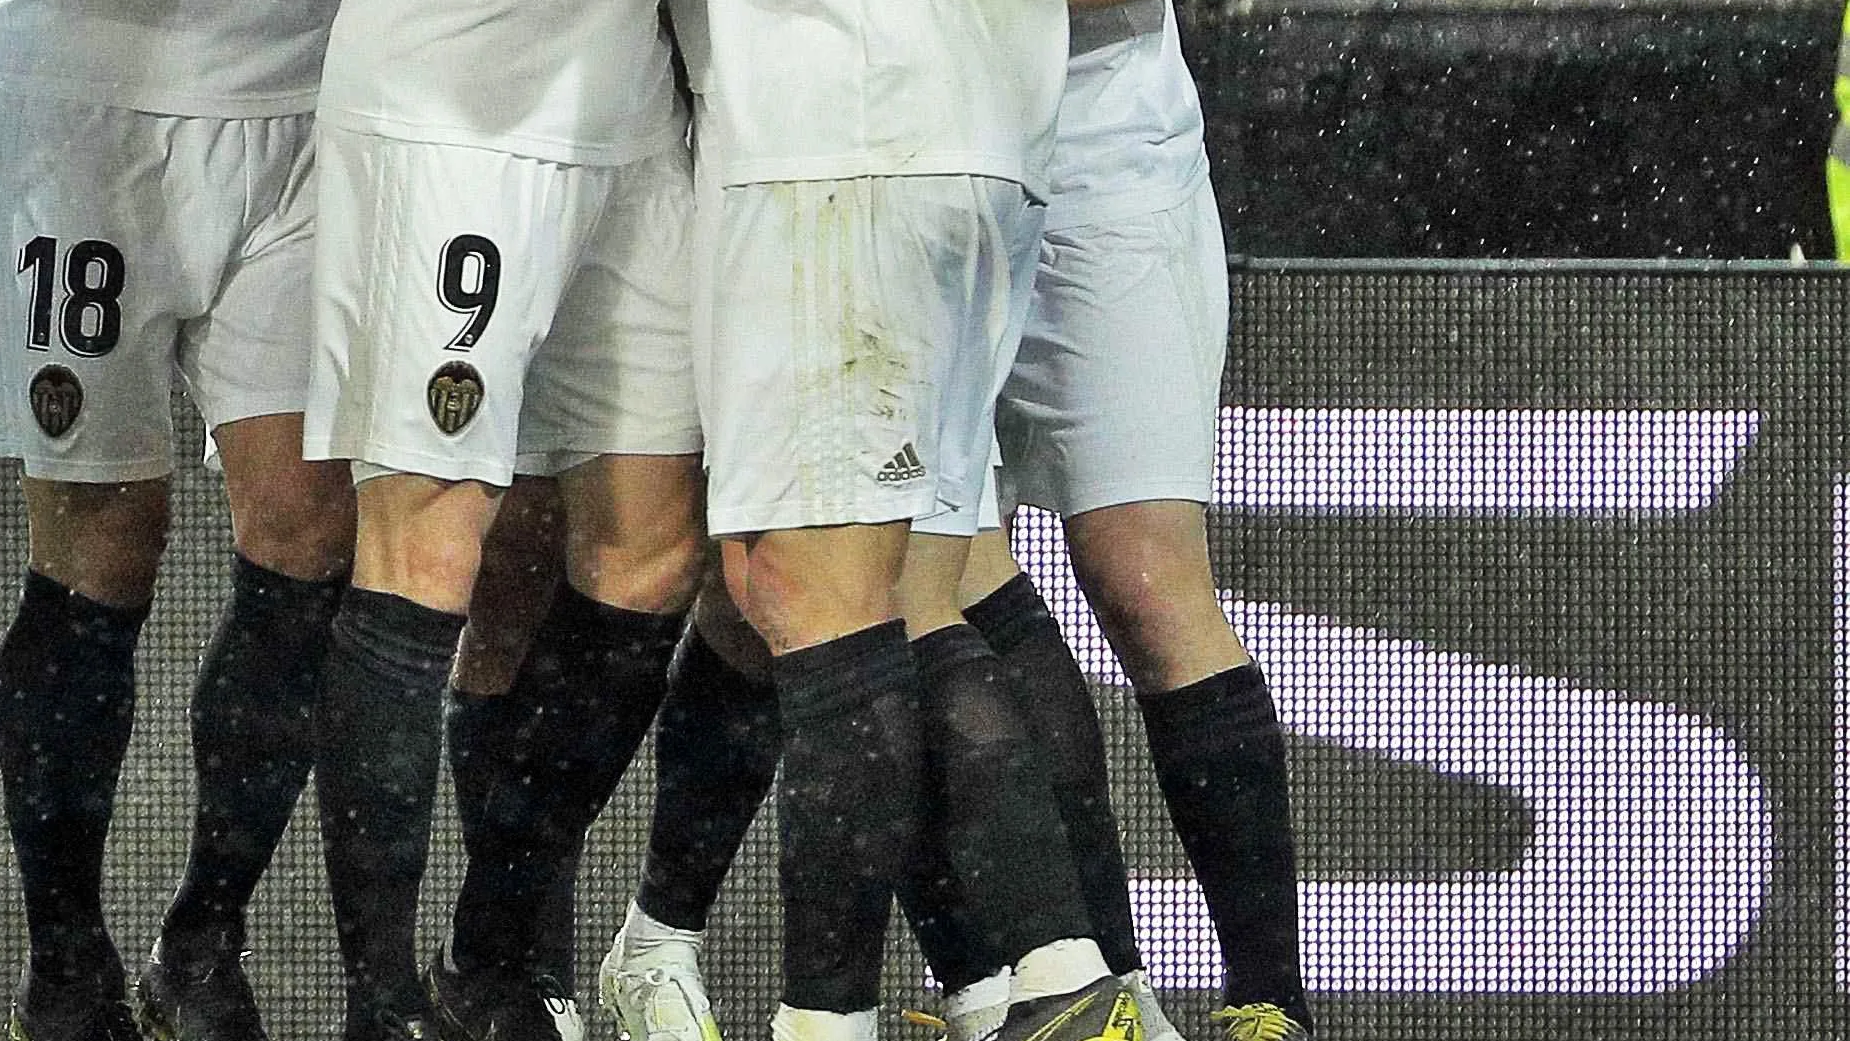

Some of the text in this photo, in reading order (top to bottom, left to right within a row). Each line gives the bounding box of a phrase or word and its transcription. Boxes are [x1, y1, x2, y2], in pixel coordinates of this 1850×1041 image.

[17, 235, 127, 359] 18
[436, 232, 503, 352] 9
[877, 466, 927, 481] adidas
